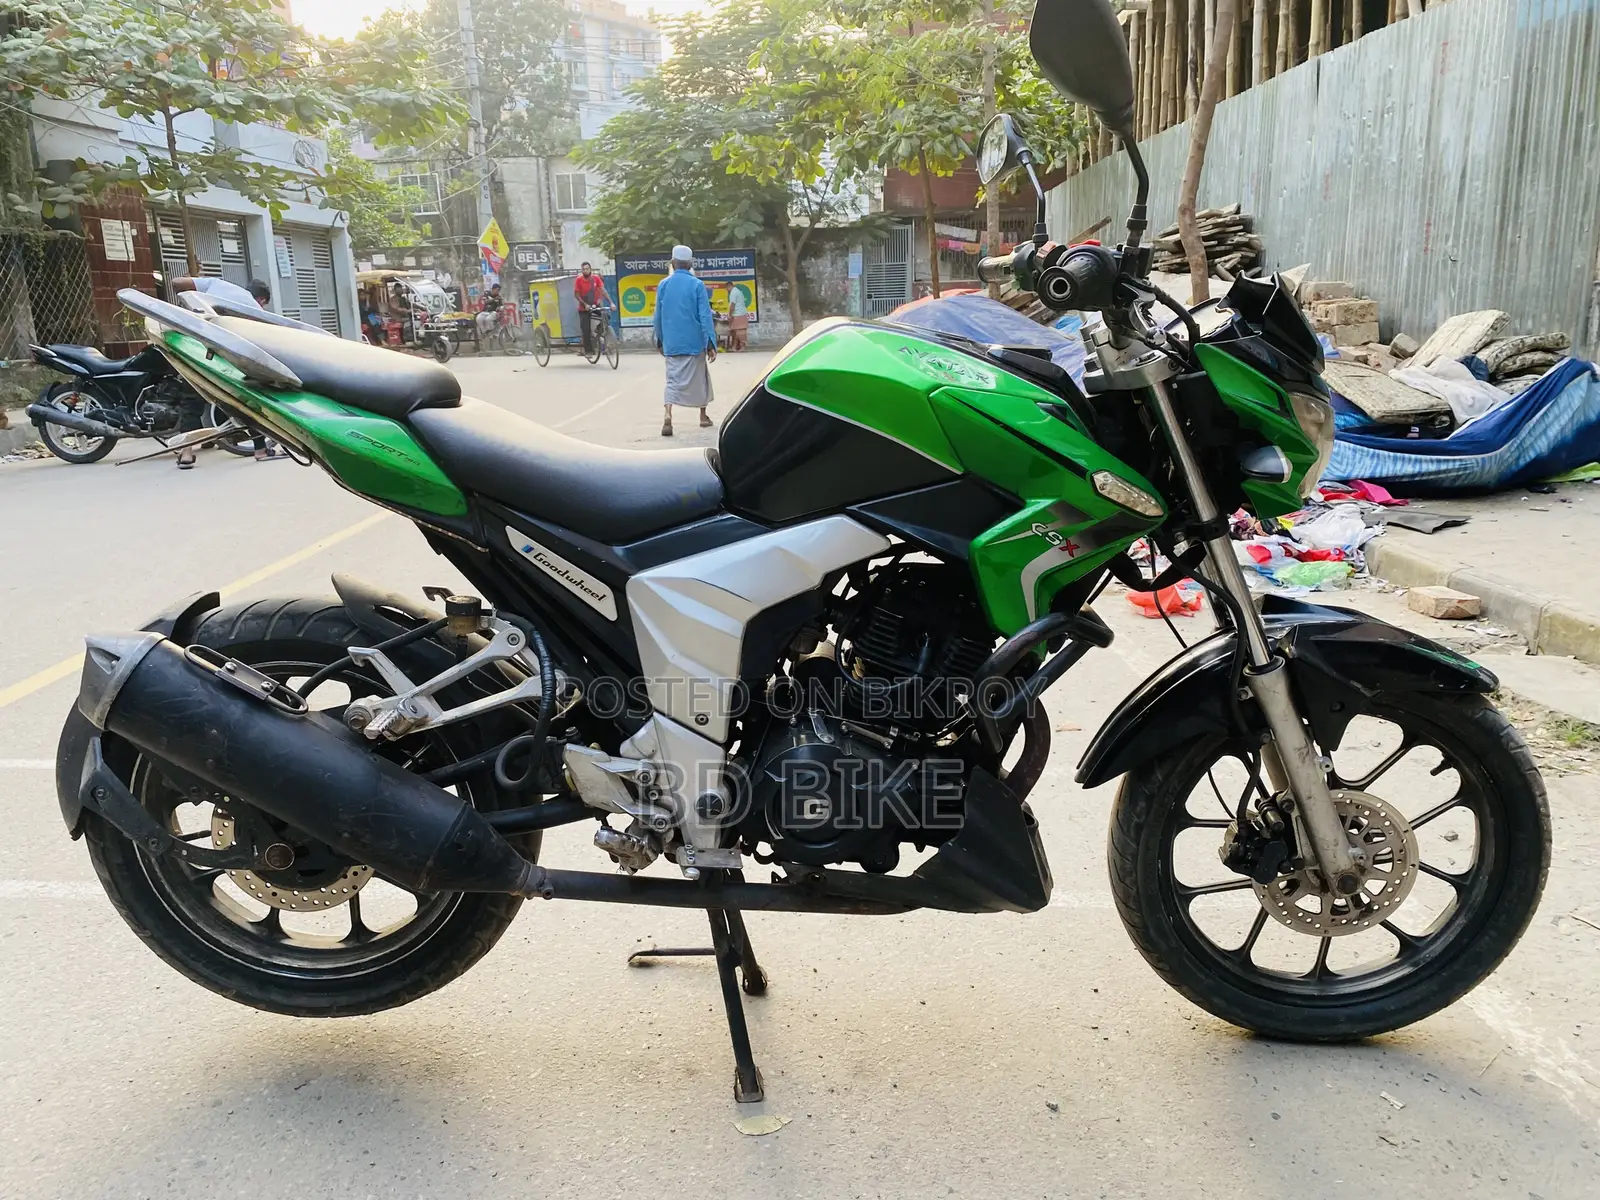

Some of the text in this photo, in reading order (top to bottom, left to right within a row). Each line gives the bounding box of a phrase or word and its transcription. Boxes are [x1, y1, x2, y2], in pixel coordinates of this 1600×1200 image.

[517, 252, 548, 263] BELS
[706, 255, 748, 268] মাদরাসা
[348, 430, 408, 458] SPORT
[1031, 522, 1081, 558] CSX
[533, 552, 607, 602] Goodwheel
[803, 799, 830, 820] G
